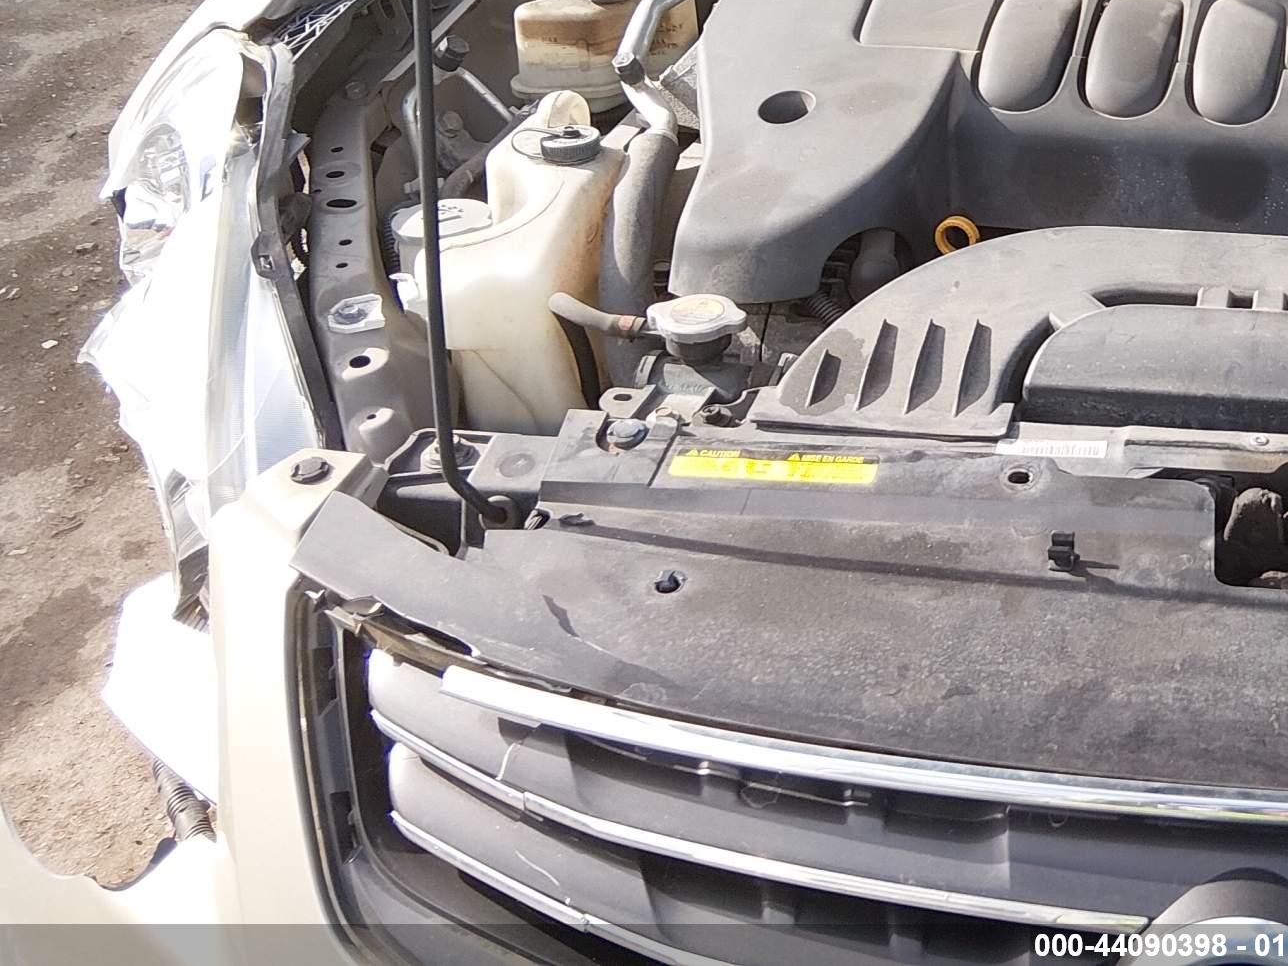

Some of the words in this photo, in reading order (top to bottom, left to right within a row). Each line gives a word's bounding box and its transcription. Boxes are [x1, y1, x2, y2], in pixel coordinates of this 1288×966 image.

[699, 449, 741, 458] CAUTION
[801, 454, 822, 463] MISE
[822, 455, 833, 463] EN
